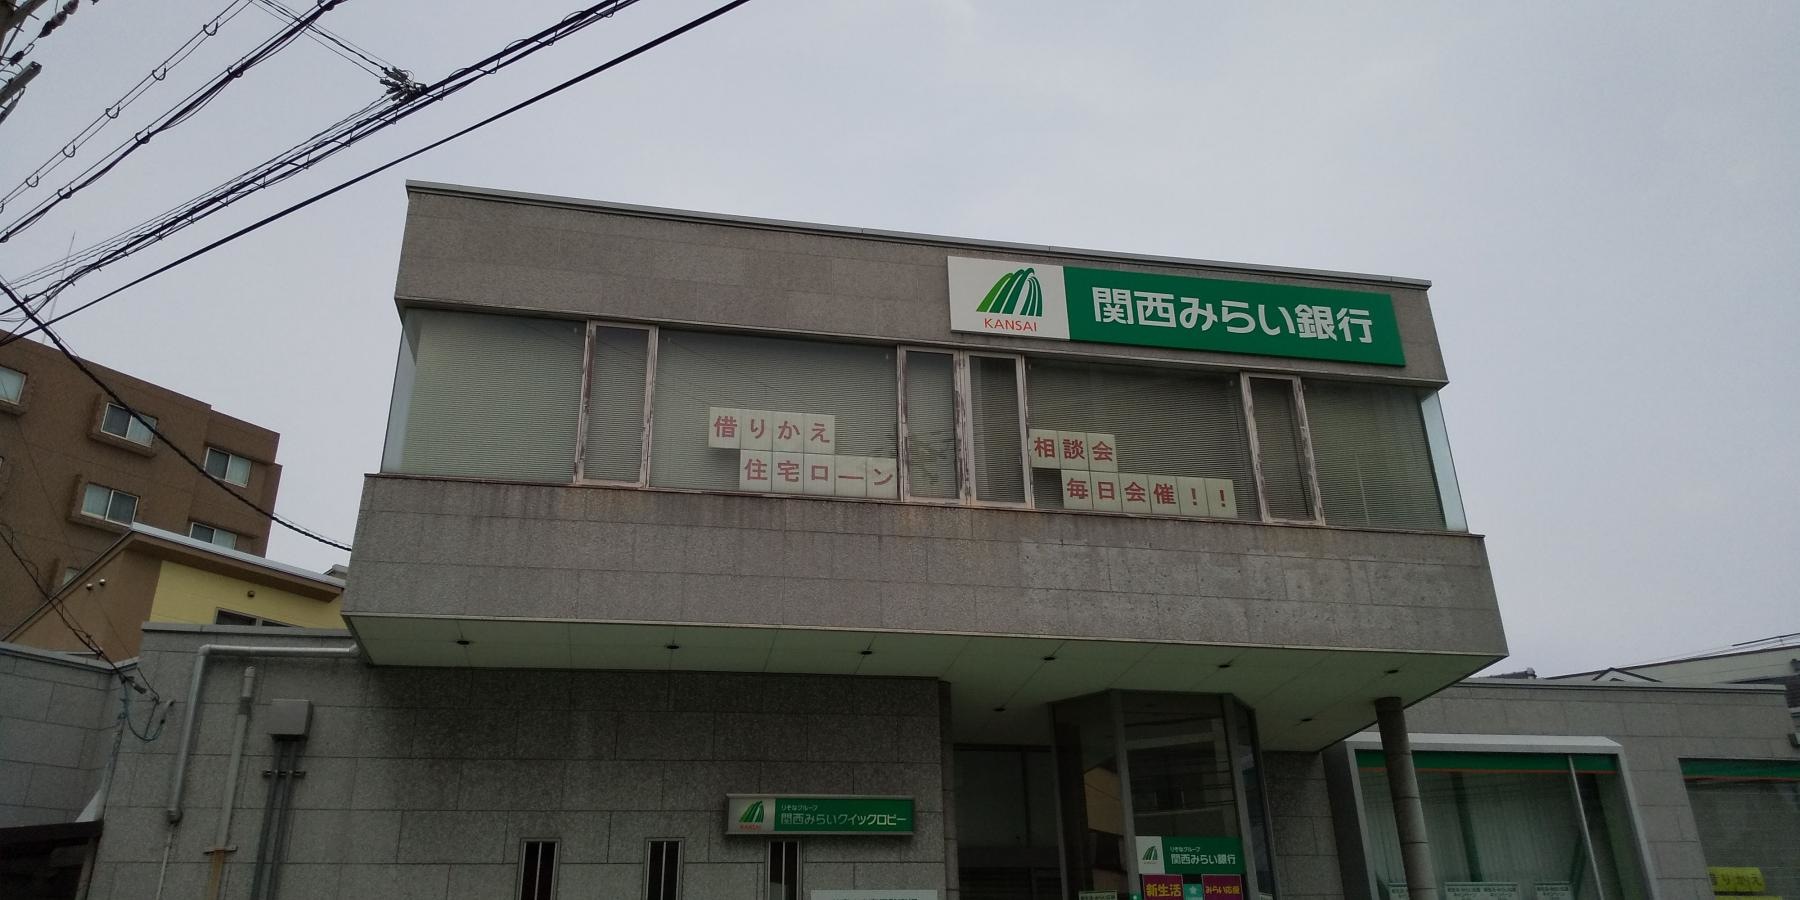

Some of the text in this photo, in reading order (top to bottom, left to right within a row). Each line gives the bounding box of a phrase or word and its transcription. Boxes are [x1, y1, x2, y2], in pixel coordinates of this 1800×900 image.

[983, 317, 1038, 333] KANSAI
[1092, 286, 1374, 345] 関西みらい銀行
[714, 415, 831, 443] 借りかえ
[1034, 437, 1114, 462] 相談会
[743, 458, 894, 487] 住宅ローン
[1170, 853, 1236, 865] 関西みらい銀行
[1145, 884, 1182, 897] 新生活
